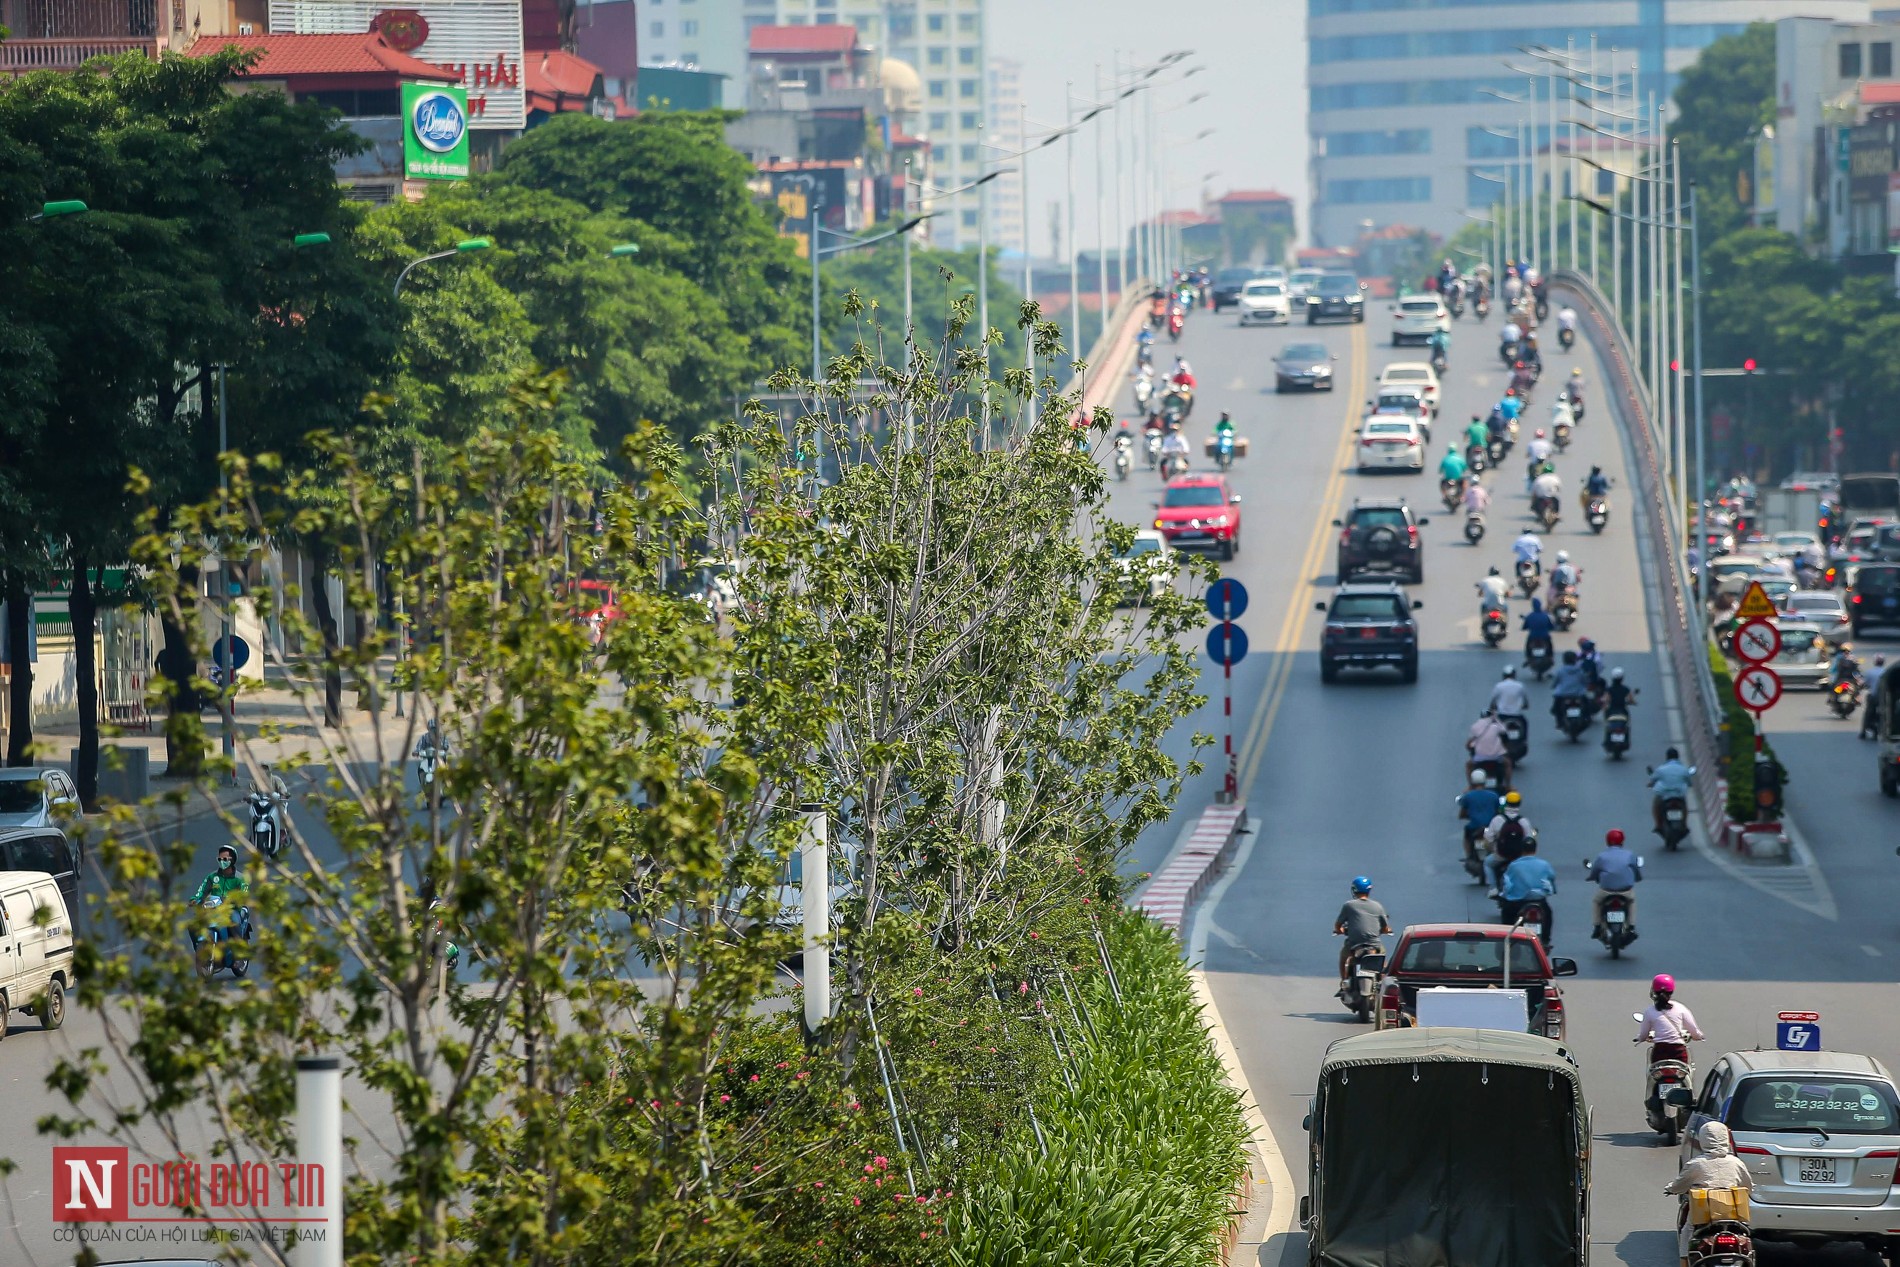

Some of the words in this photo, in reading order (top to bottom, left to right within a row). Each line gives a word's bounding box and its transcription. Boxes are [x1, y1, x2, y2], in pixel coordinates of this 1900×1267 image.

[1787, 1026, 1811, 1048] G7
[1792, 1100, 1808, 1109] 32
[1809, 1101, 1825, 1110] 32
[1826, 1101, 1842, 1110] 32
[1843, 1102, 1859, 1111] 32
[1808, 1159, 1827, 1170] 30A
